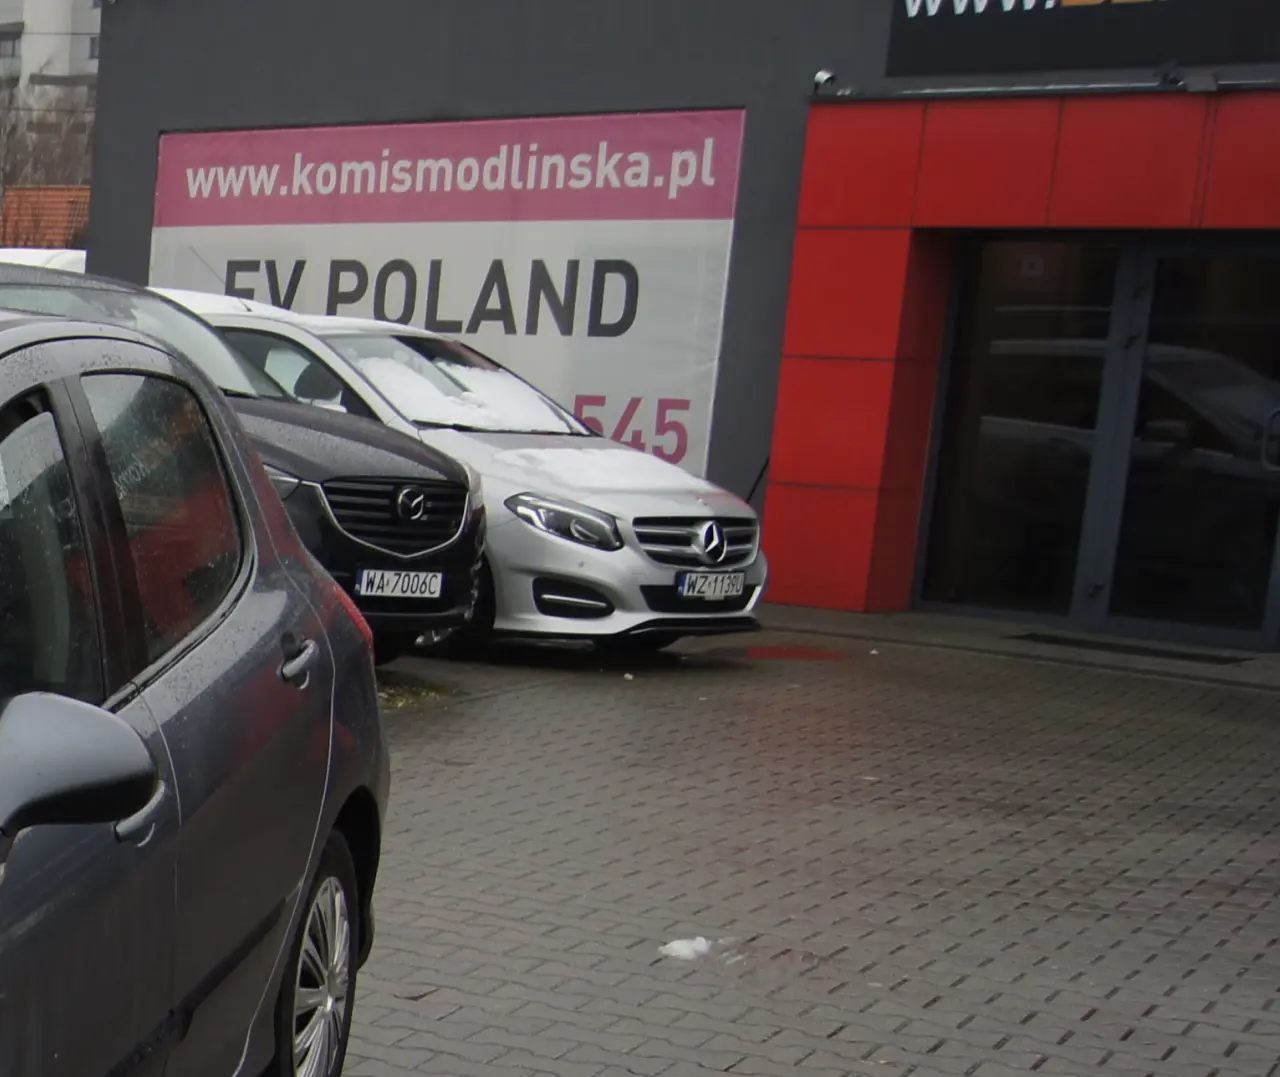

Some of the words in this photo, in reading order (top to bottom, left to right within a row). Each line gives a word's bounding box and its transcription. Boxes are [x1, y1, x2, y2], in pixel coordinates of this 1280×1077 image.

[185, 137, 717, 199] www.komismodlinska.pl
[325, 258, 640, 338] POLAND
[365, 571, 386, 593] WA
[390, 572, 438, 595] 7006C
[687, 575, 709, 594] WZ
